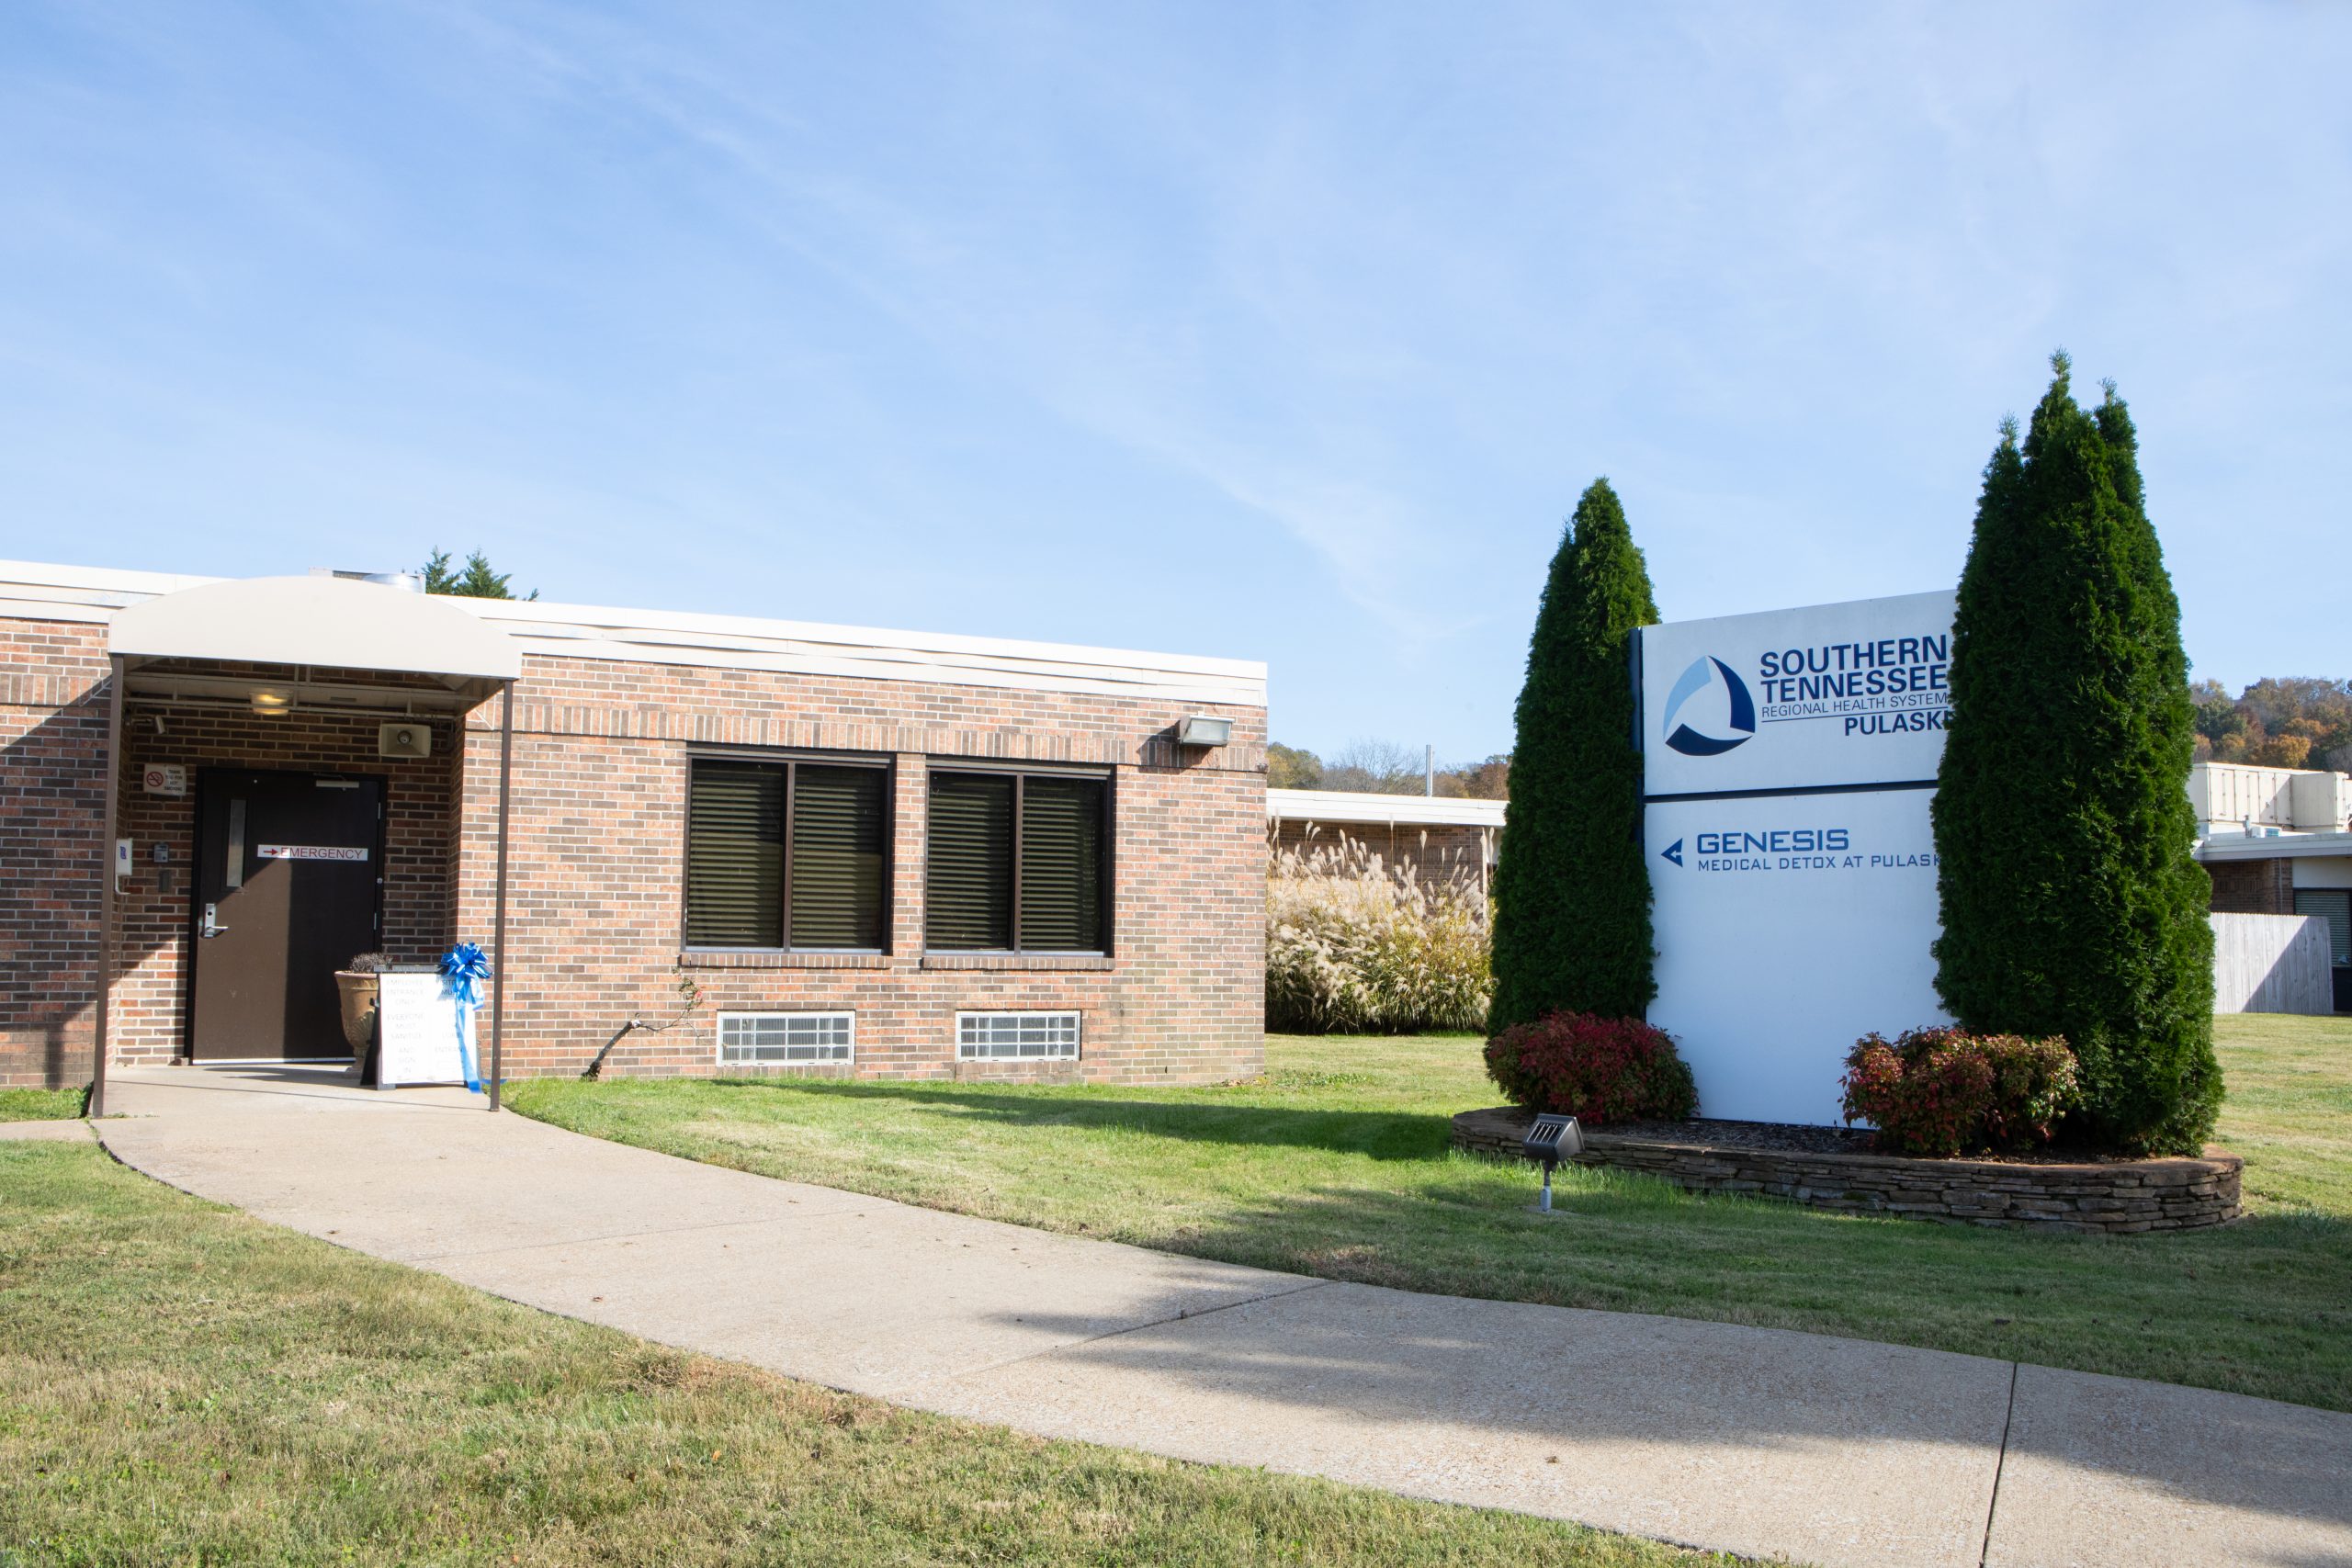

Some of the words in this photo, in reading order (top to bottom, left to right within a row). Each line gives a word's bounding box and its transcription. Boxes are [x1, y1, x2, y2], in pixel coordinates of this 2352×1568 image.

[1759, 634, 1947, 678] SOUTHERN
[1760, 663, 1948, 704] TENNESSEE
[1761, 702, 1828, 718] REGIONAL
[1833, 697, 1884, 714] HEALTH
[1890, 692, 1948, 708] SYSTEM
[280, 847, 364, 859] EMERGENCY
[1697, 829, 1849, 855] GENESIS
[1698, 858, 1771, 872] MEDICAL
[1779, 856, 1837, 870] DETOX
[1843, 855, 1863, 868] AT
[1871, 853, 1940, 868] PULASK
